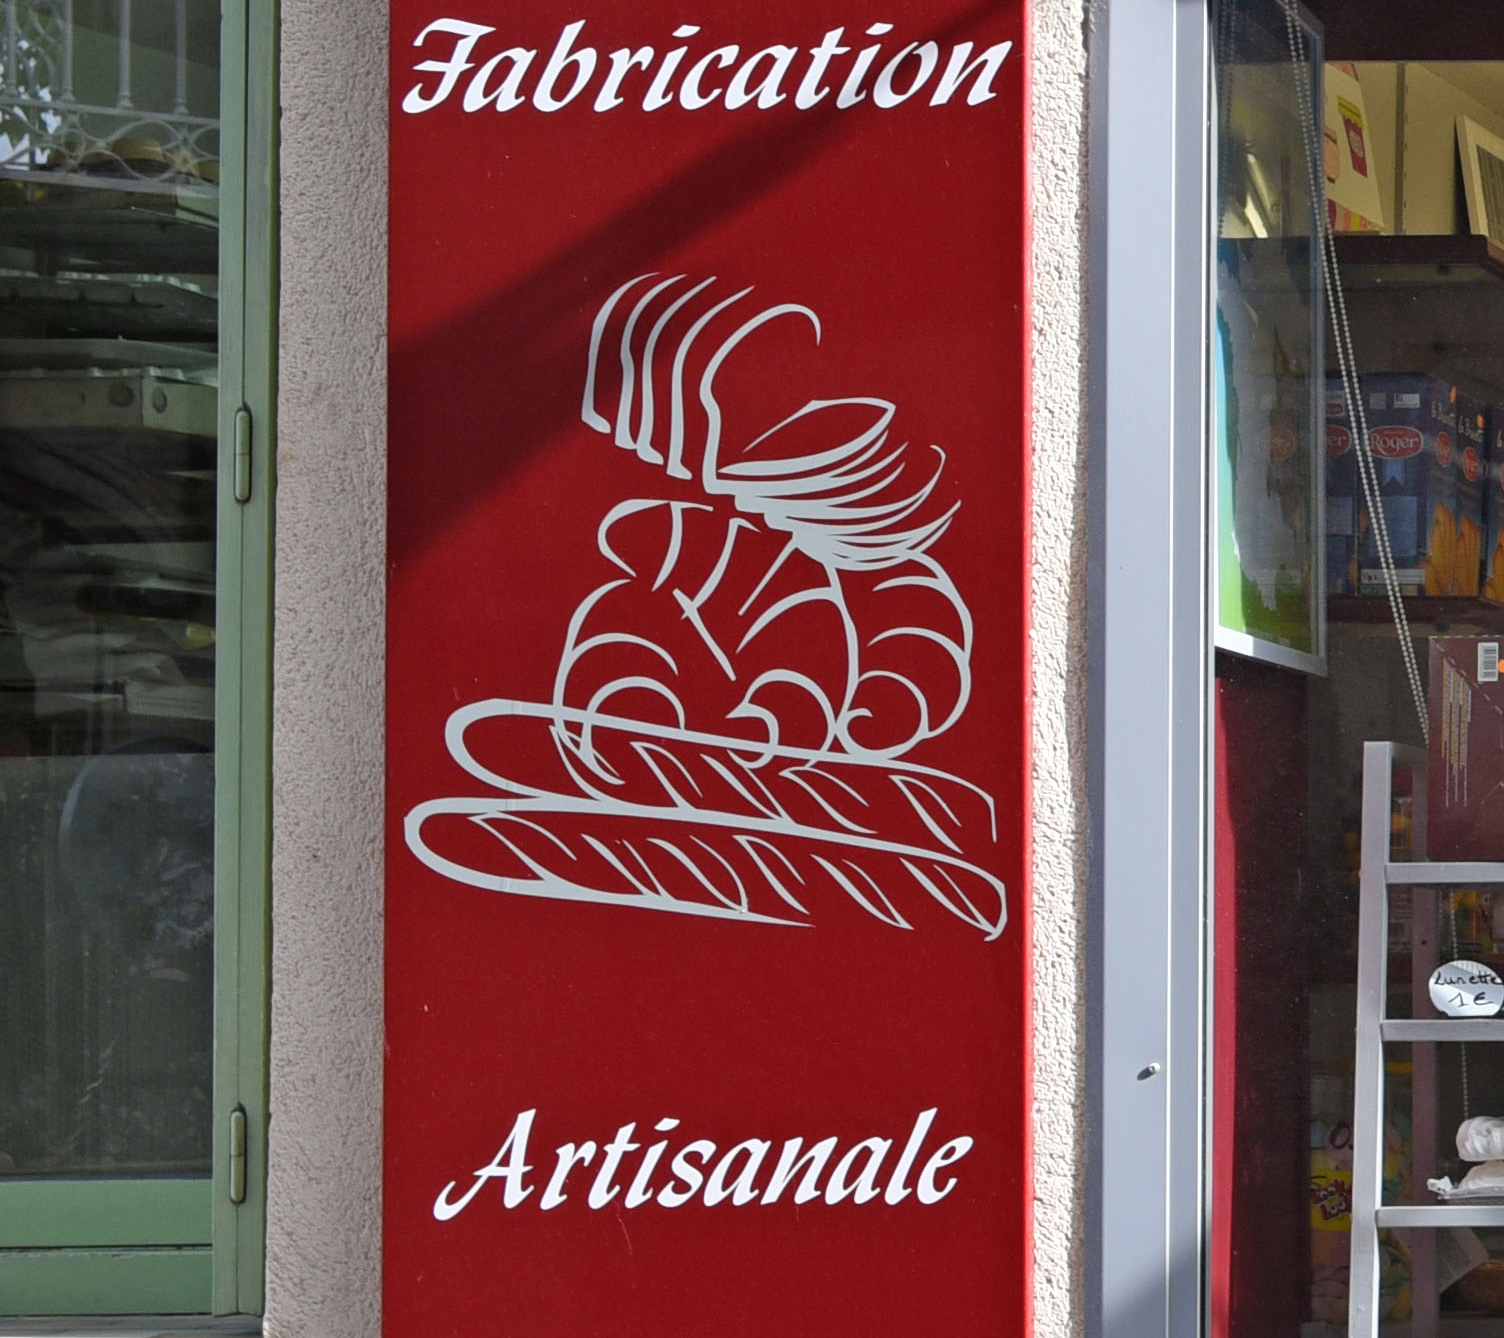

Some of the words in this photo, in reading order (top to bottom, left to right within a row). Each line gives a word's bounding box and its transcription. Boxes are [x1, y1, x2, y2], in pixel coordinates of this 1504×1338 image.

[401, 18, 1012, 114] Fabrication
[1370, 433, 1420, 456] Roger
[1434, 972, 1504, 985] Lunette
[433, 1107, 973, 1221] Artisanale
